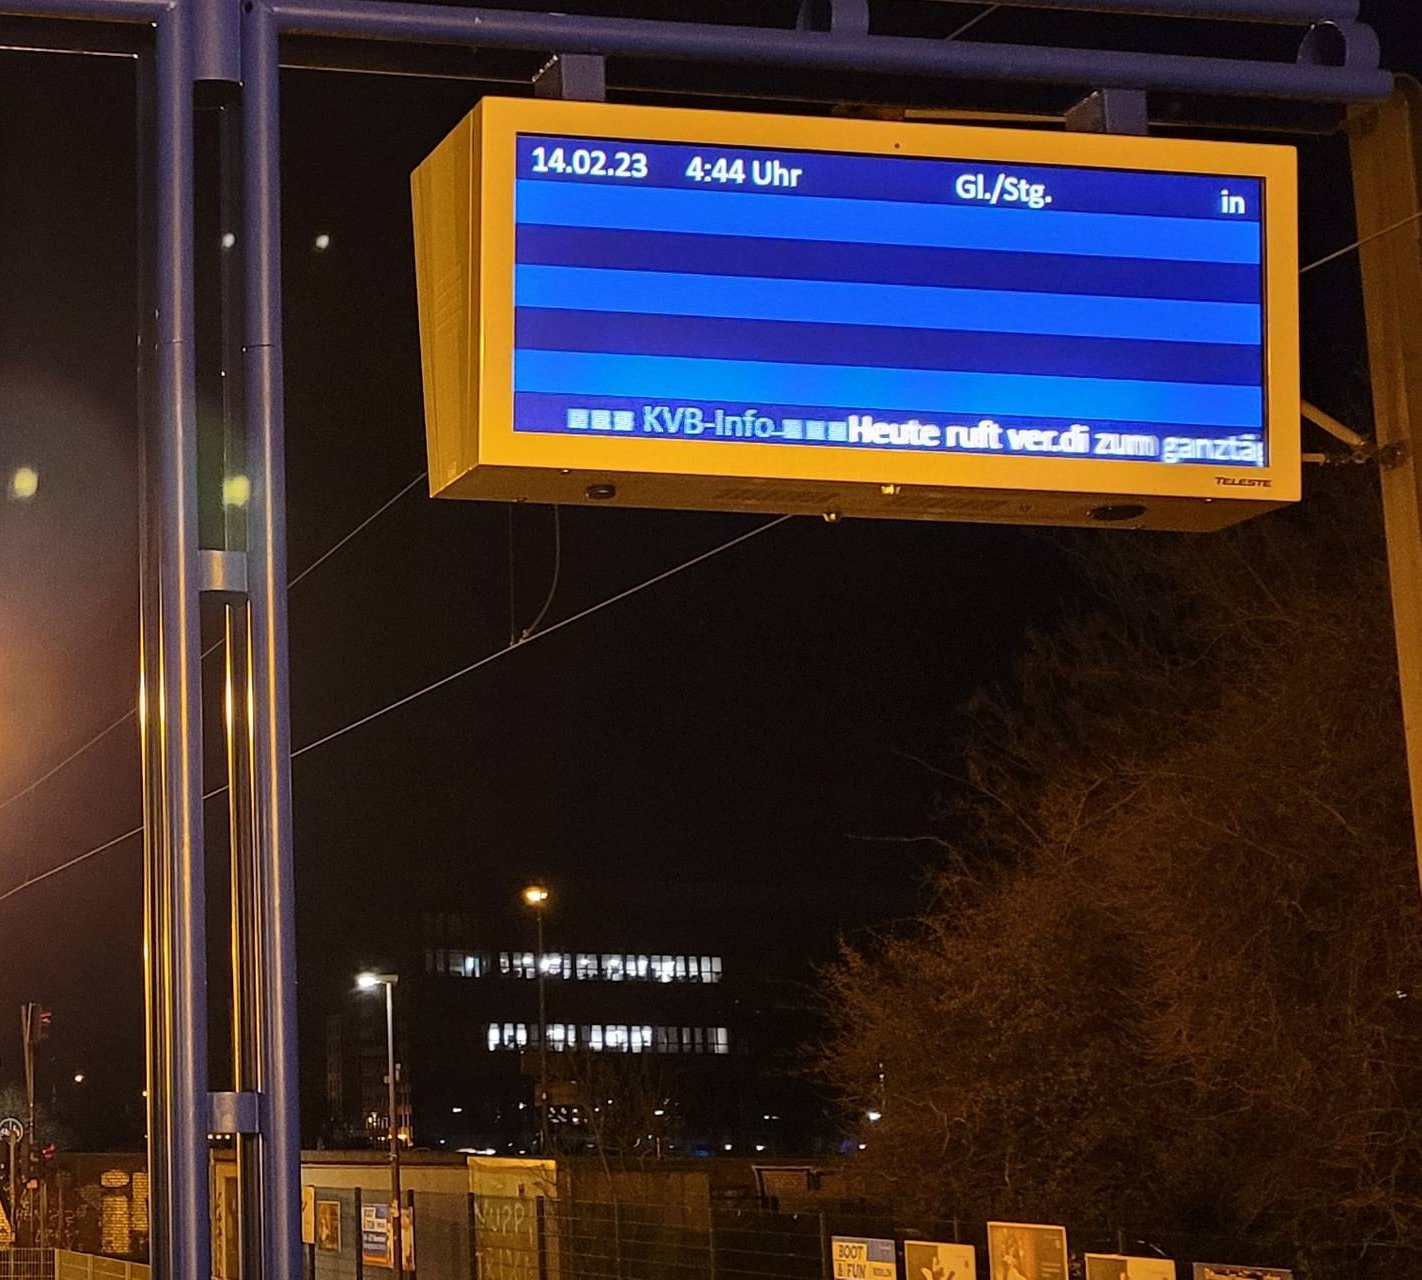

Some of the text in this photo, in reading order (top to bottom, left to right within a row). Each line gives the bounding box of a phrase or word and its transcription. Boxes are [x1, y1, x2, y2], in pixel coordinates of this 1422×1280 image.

[531, 146, 803, 188] 14.02.23 4:44 Uhr
[955, 172, 1053, 209] Gl./Stg.
[1220, 190, 1246, 214] in
[642, 405, 776, 439] KVB-Info
[846, 414, 943, 447] Heute
[945, 419, 1004, 451] ruft
[1006, 423, 1091, 455] ver.di
[1094, 431, 1159, 457] zum
[1214, 476, 1273, 488] TELESTE
